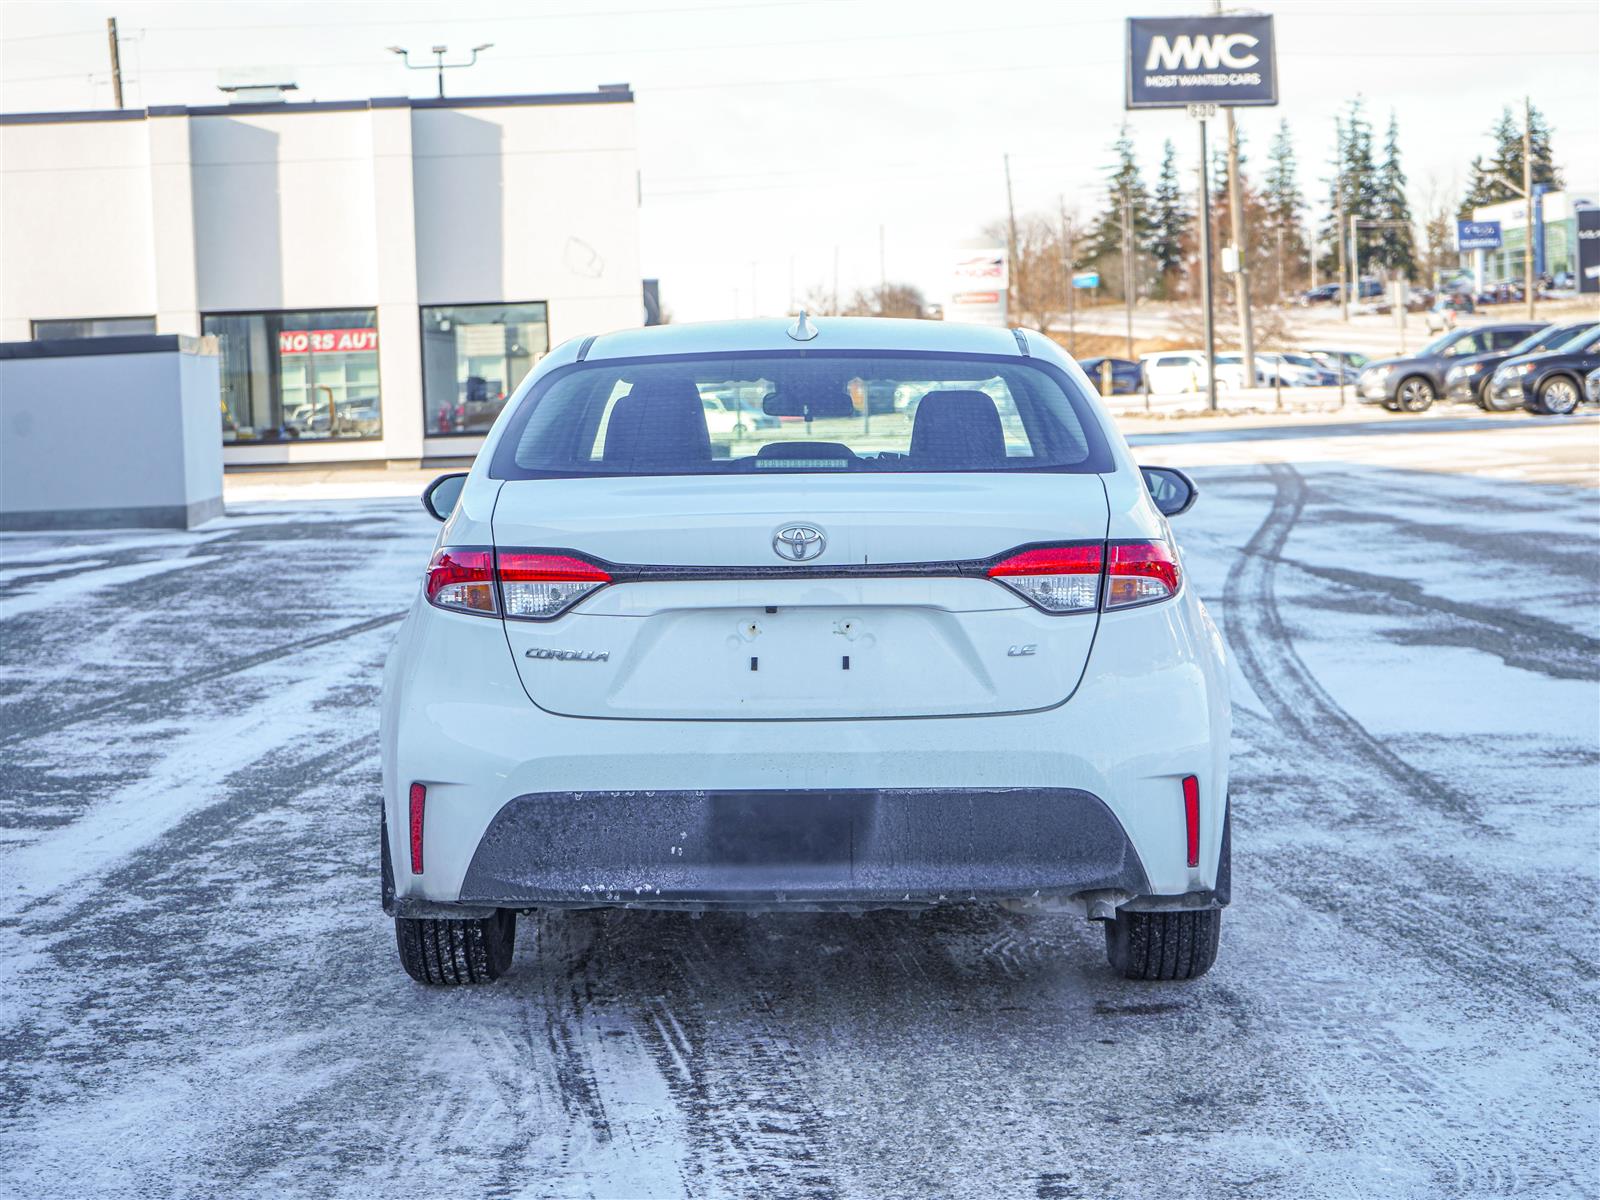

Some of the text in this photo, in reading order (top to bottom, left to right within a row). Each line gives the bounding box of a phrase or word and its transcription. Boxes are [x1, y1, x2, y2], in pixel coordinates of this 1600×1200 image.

[1145, 33, 1259, 71] MWC
[1144, 72, 1261, 88] MOST WANTED CARS
[525, 647, 610, 663] COROLLA
[1007, 641, 1038, 657] LE
